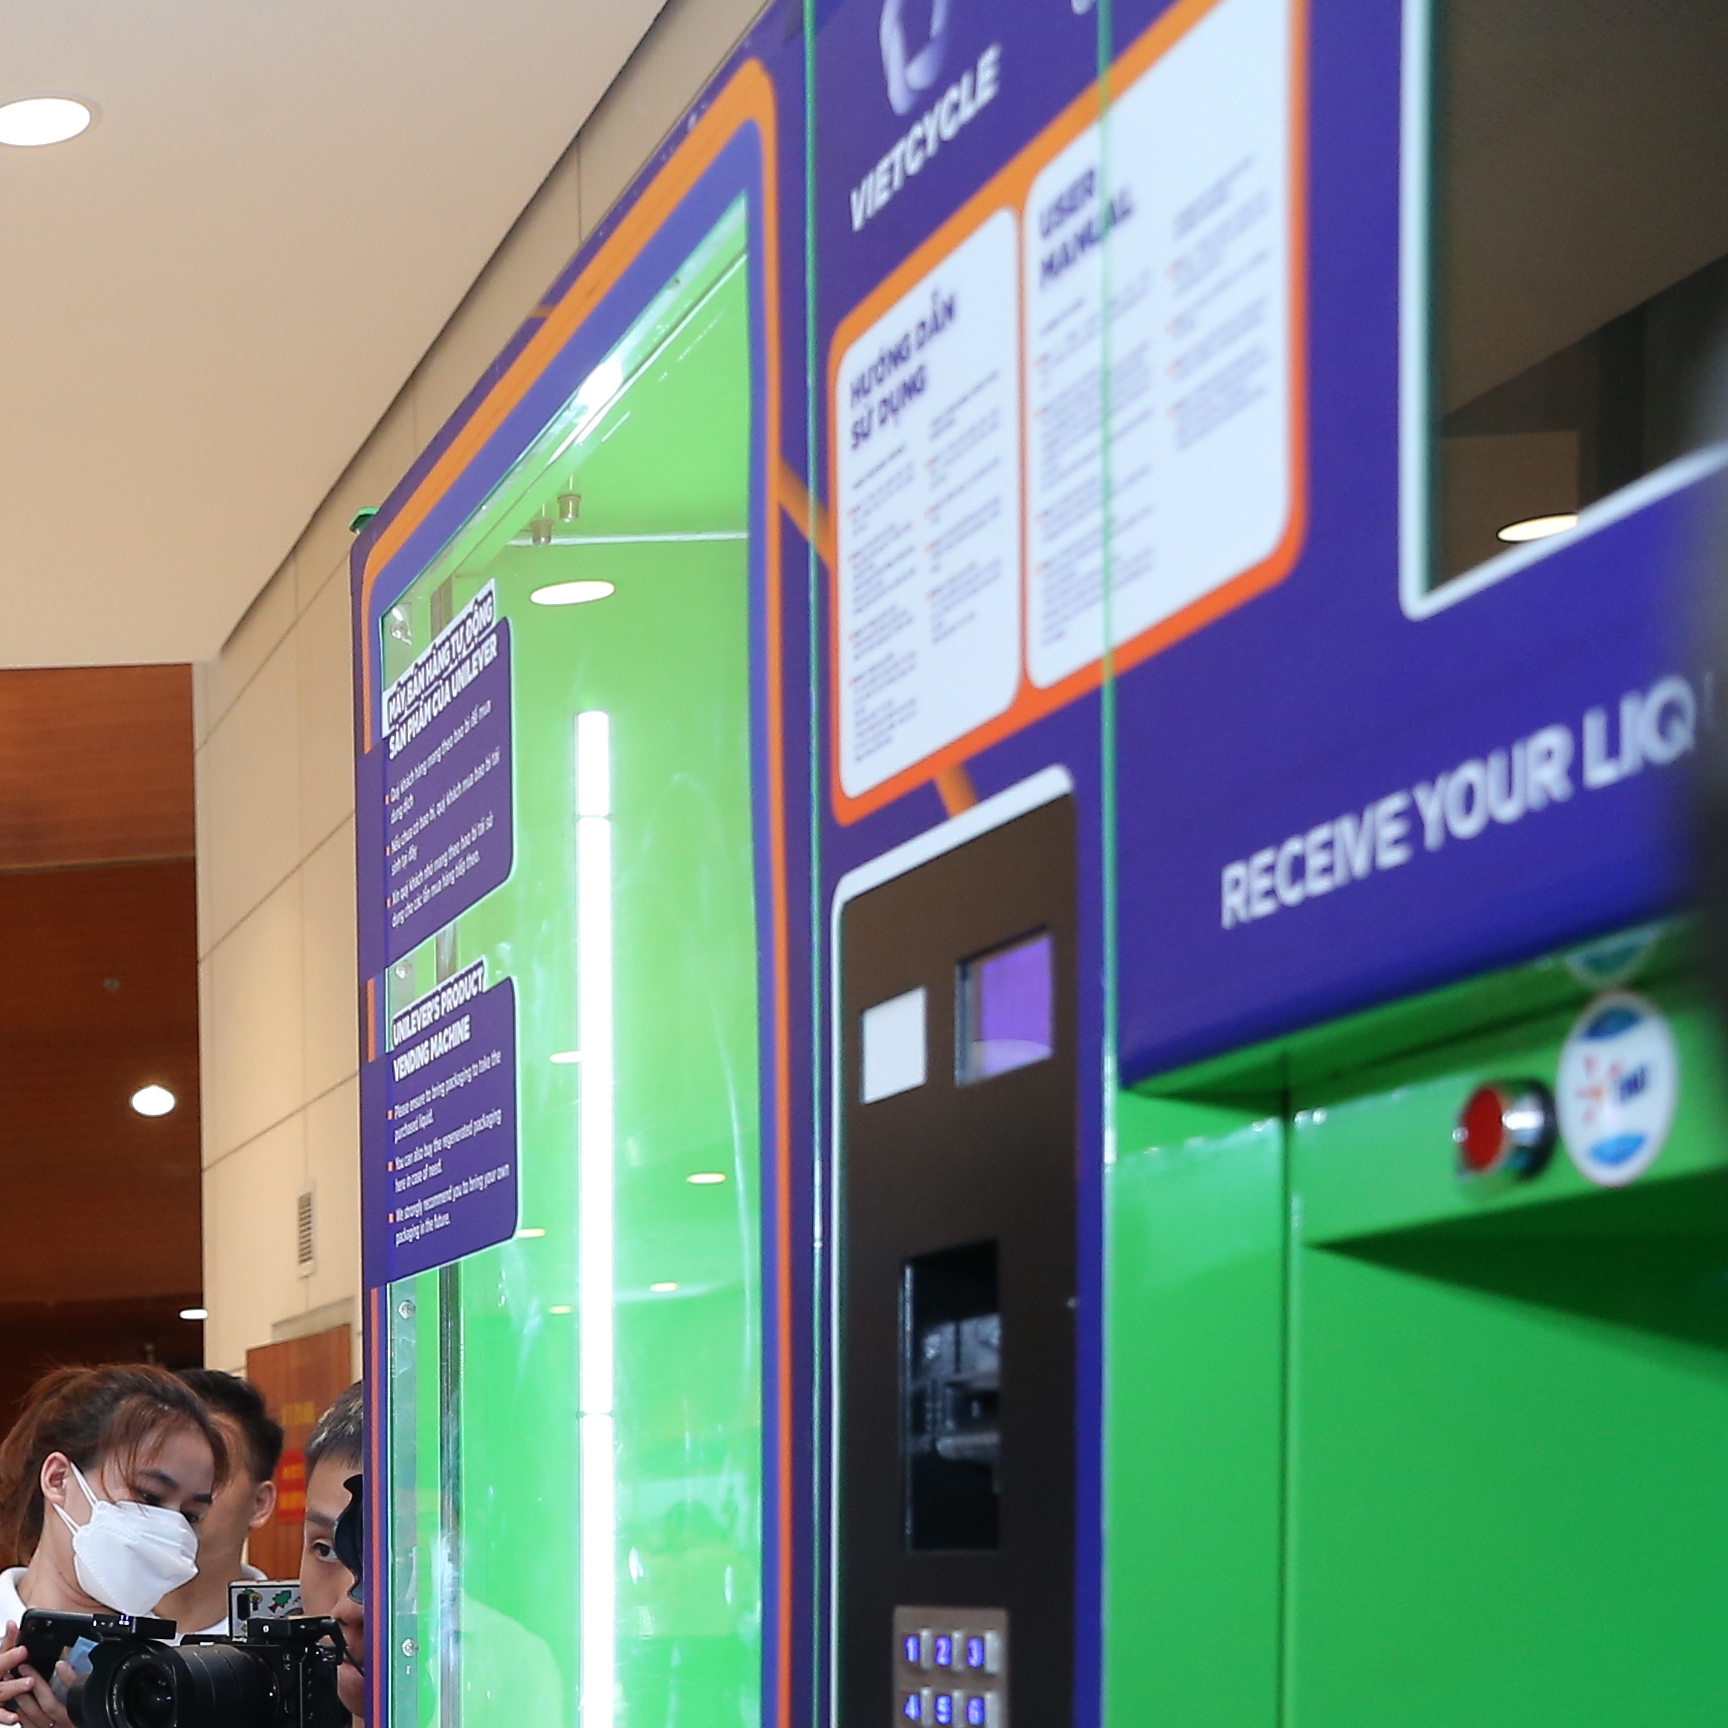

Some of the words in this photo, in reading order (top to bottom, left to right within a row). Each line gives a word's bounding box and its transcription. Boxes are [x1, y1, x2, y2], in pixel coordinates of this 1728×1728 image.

[850, 42, 1001, 232] VIETCYCLE
[389, 678, 406, 723] MÁY
[407, 659, 425, 703] BÁN
[425, 635, 451, 688] HÀNG
[465, 592, 493, 648] ĐỘNG
[389, 722, 406, 762] SẢN
[407, 690, 433, 744] PHẨM
[432, 676, 451, 719] CỦA
[451, 632, 498, 701] UNILEVER
[1220, 789, 1412, 930] RECEIVE
[1413, 722, 1575, 852] YOUR
[1582, 673, 1712, 790] LIQ
[441, 964, 484, 1016] PRODUCT
[393, 1040, 429, 1081] VENDING
[430, 1015, 469, 1059] MACHINE
[394, 1102, 409, 1119] Please
[409, 1093, 425, 1111] ensure
[431, 1081, 445, 1099] bring
[445, 1067, 472, 1094] packaging
[478, 1055, 490, 1073] take
[490, 1049, 501, 1066] the
[394, 1117, 418, 1144] purchased
[418, 1108, 433, 1128] liquid.
[395, 1156, 404, 1170] You
[404, 1152, 413, 1166] can
[413, 1146, 423, 1162] also
[423, 1143, 432, 1157] buy
[432, 1137, 441, 1152] the
[442, 1119, 472, 1149] regenerated
[473, 1108, 501, 1136] packaging
[394, 1177, 405, 1192] here
[411, 1170, 422, 1185] case
[428, 1158, 442, 1177] need.
[395, 1207, 403, 1222] We
[403, 1198, 422, 1219] strongly
[423, 1184, 452, 1210] recommend
[452, 1184, 462, 1202] you
[468, 1174, 483, 1191] bring
[483, 1169, 496, 1188] your
[496, 1163, 509, 1180] own
[395, 1224, 419, 1247] packaging
[424, 1217, 433, 1233] the
[433, 1212, 450, 1228] future.
[905, 1635, 920, 1663] 1
[935, 1635, 951, 1666] 2
[967, 1637, 984, 1667] 3
[904, 1694, 921, 1721] 4
[935, 1695, 952, 1725] 5
[967, 1697, 985, 1726] 6
